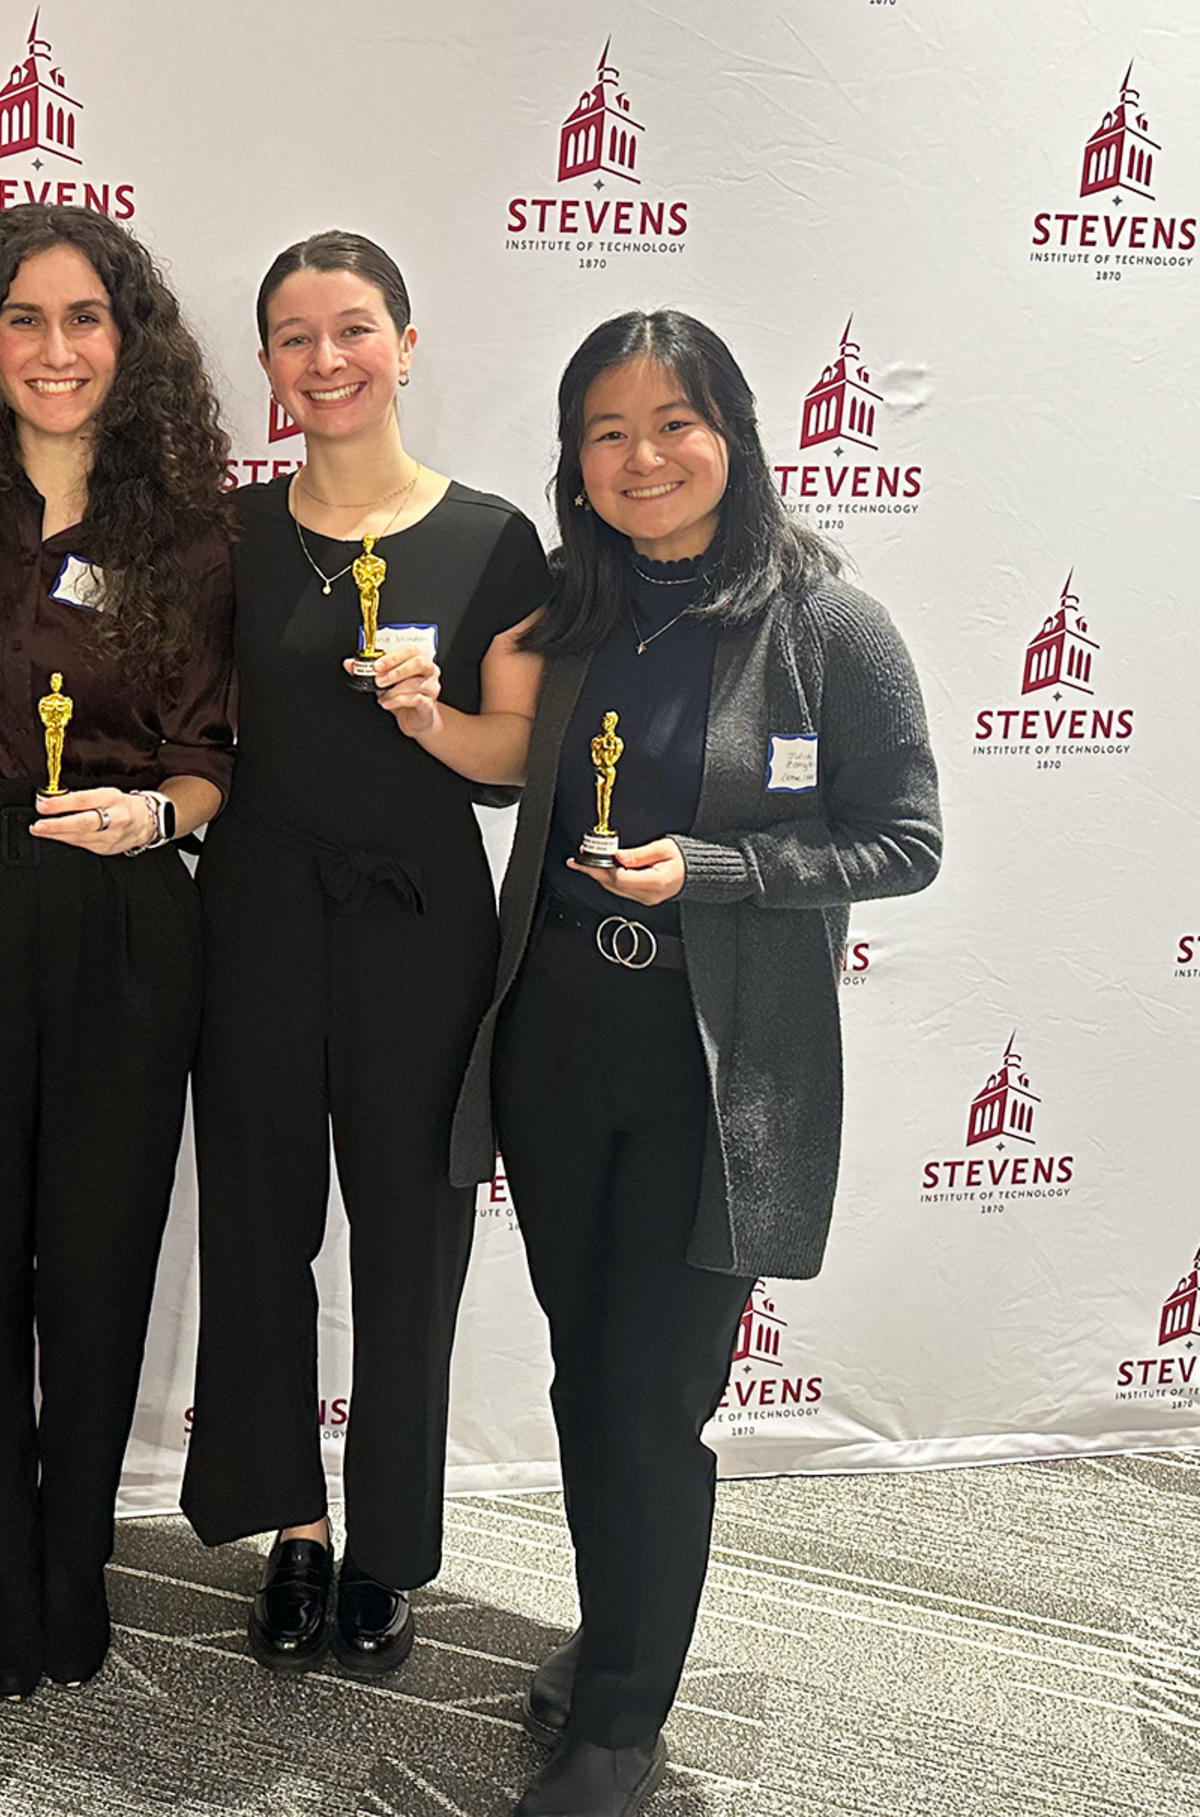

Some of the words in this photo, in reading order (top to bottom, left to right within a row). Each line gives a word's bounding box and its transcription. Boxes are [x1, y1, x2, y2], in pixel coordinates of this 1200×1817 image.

[507, 198, 688, 236] STEVENS
[1032, 213, 1197, 250] STEVENS
[505, 240, 571, 251] INSTITUTE
[576, 241, 594, 252] OF
[599, 241, 686, 253] TECHNOLOGY
[579, 259, 607, 269] 1870
[1030, 252, 1090, 264] INSTITUTE
[1094, 254, 1110, 264] OF
[1115, 254, 1194, 267] TECHNOLOGY
[1096, 271, 1121, 281] 1870
[774, 466, 922, 498] TEVENS
[815, 504, 832, 514] OF
[837, 504, 919, 514] TECHNOLOGY
[817, 520, 844, 529] 1870
[975, 709, 1134, 740] STEVENS
[973, 746, 1031, 755] INSTITUTE
[1034, 745, 1051, 755] OF
[1055, 745, 1130, 754] TECHNOLOGY
[1036, 760, 1061, 769] 1870
[922, 1156, 1074, 1189] STEVENS
[920, 1192, 975, 1203] INSTITUTE
[979, 1191, 994, 1200] OF
[999, 1188, 1071, 1200] TECHNOLOGY
[981, 1205, 1004, 1214] 1870
[1117, 1356, 1197, 1386] STEV
[1115, 1389, 1166, 1400] INSTITUTE
[1169, 1388, 1184, 1396] OF
[728, 1412, 742, 1422] OF
[748, 1407, 820, 1420] TECHNOLOGY
[731, 1427, 755, 1436] 1870
